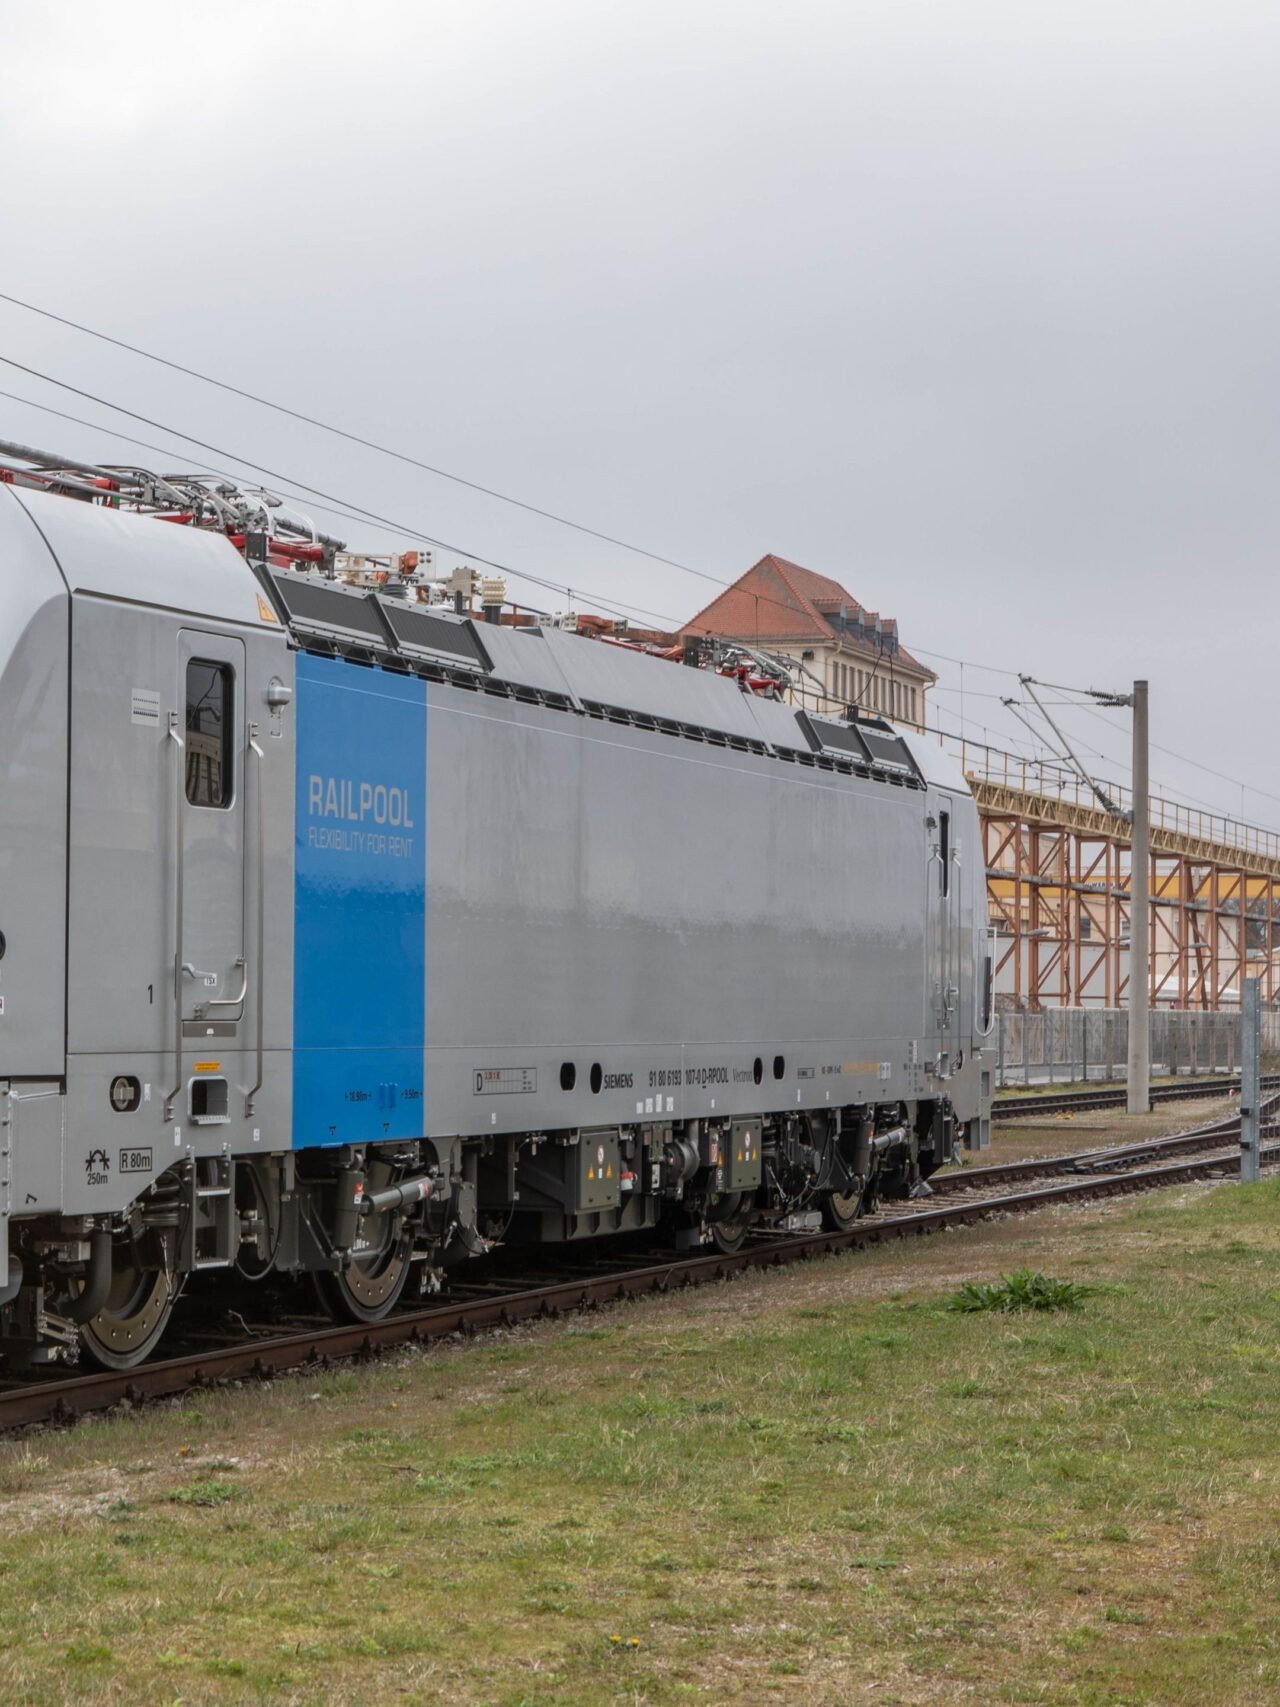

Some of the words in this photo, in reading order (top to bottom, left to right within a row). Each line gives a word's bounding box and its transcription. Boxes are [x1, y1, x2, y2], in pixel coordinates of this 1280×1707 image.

[308, 774, 414, 828] RAILPOOL
[308, 826, 364, 852] FLEXIBILITY
[367, 833, 386, 855] FOR
[388, 836, 414, 858] RENT
[147, 984, 153, 1004] 1
[476, 1072, 483, 1091] D
[604, 1073, 634, 1089] SIEMENS
[648, 1070, 657, 1087] 91
[658, 1070, 666, 1086] 80
[667, 1069, 682, 1086] 6193
[121, 1152, 128, 1168] R
[130, 1152, 150, 1168] 80m
[87, 1172, 108, 1185] 250m
